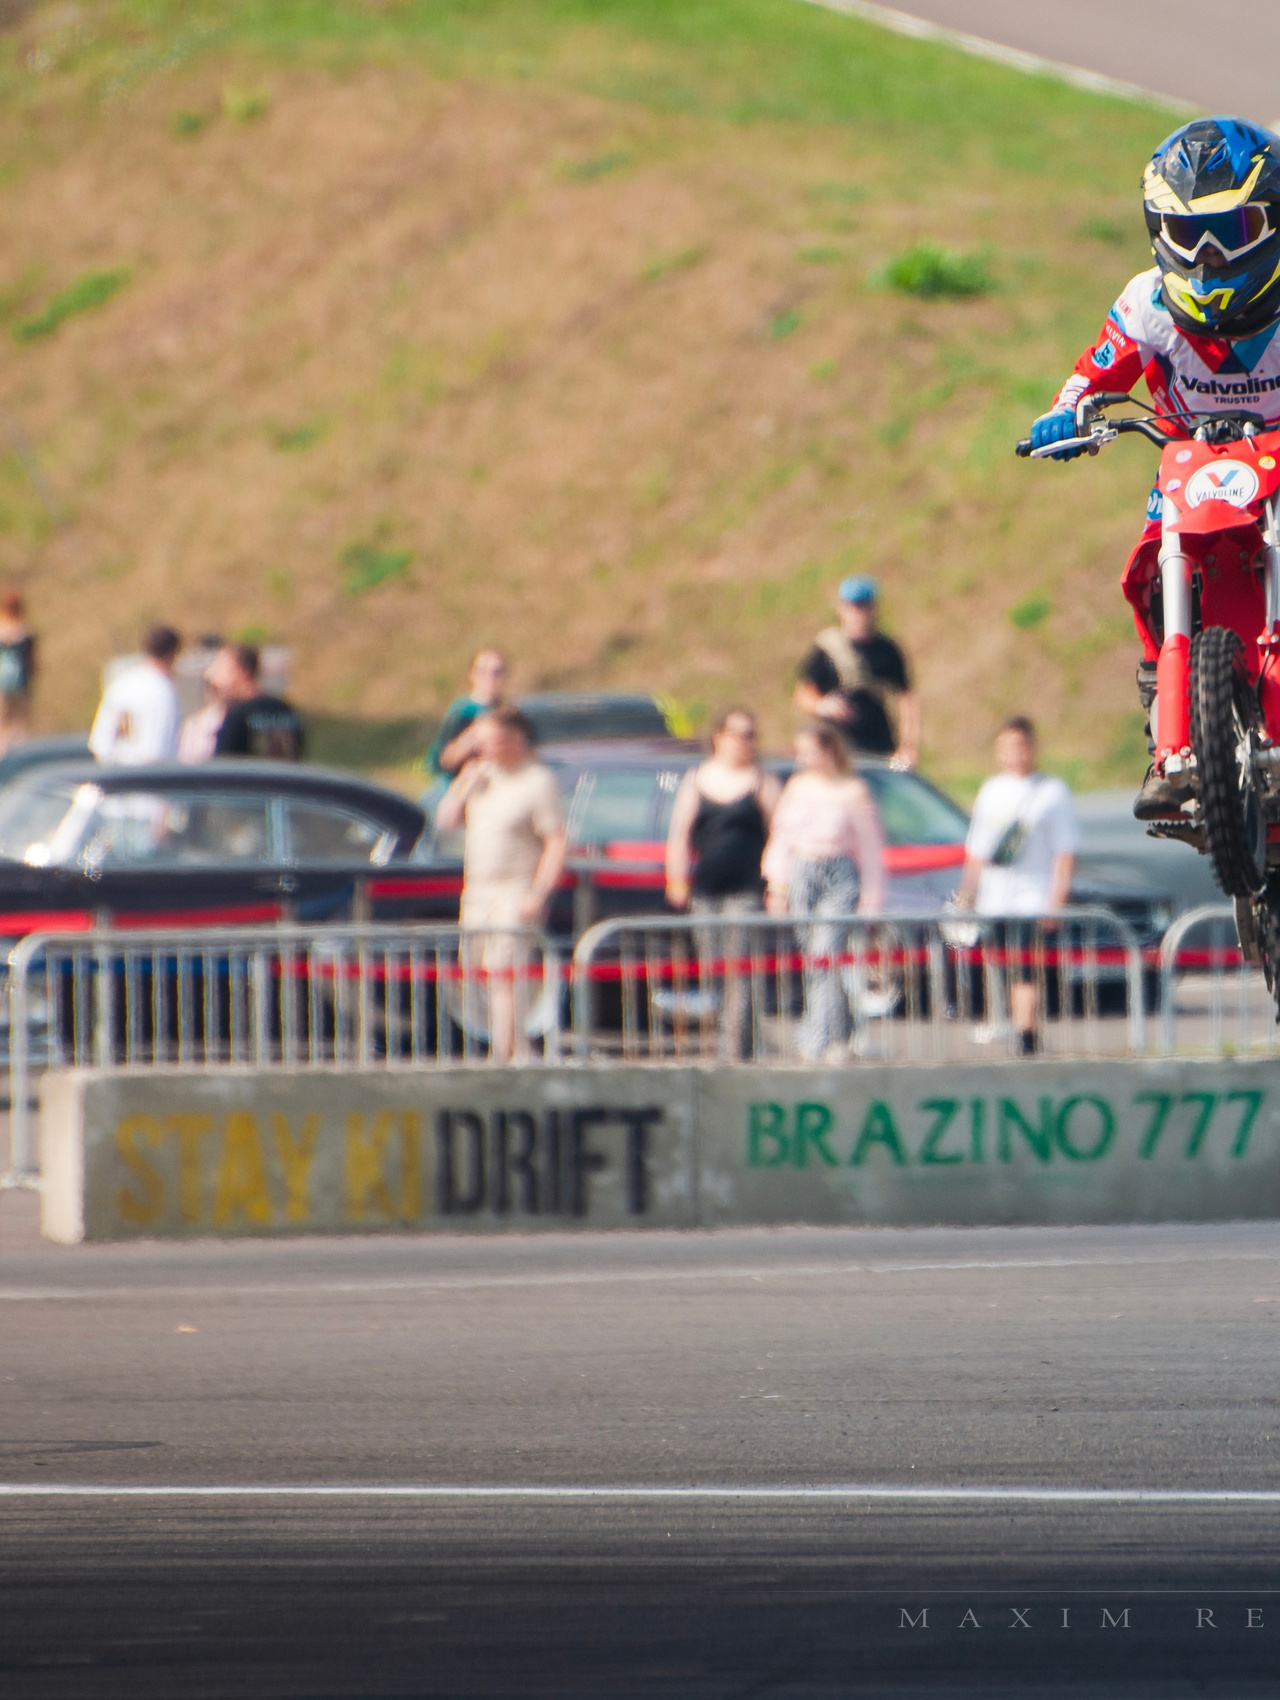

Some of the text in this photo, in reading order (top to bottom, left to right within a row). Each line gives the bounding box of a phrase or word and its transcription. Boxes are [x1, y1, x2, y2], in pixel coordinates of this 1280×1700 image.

[1213, 396, 1261, 405] TRUSTED
[1196, 486, 1245, 500] VALVOLINE
[115, 1111, 320, 1225] STAY
